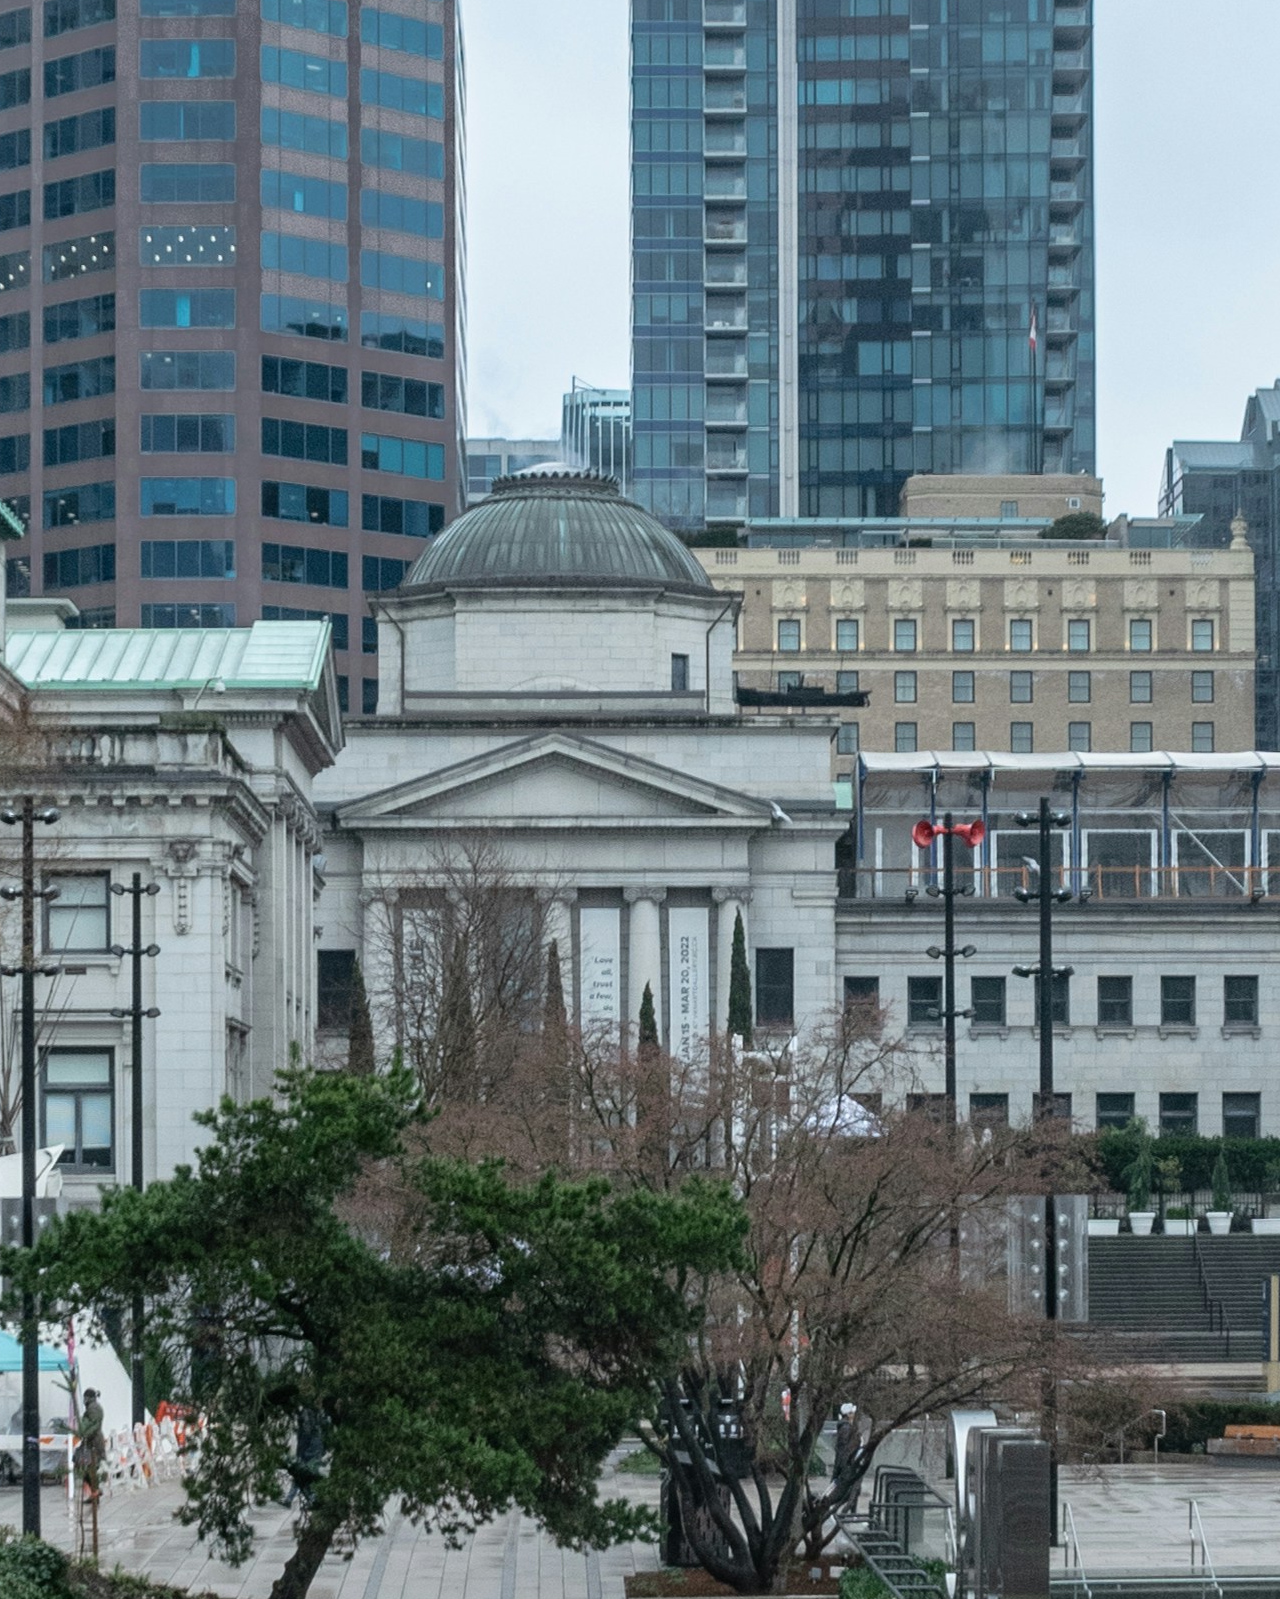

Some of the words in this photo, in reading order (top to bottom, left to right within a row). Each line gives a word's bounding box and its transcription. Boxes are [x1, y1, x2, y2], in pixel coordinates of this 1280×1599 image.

[681, 936, 689, 964] 2022
[681, 966, 691, 984] 20,
[681, 987, 690, 1014] MAR
[681, 1023, 690, 1034] 15
[681, 1036, 690, 1060] JAN
